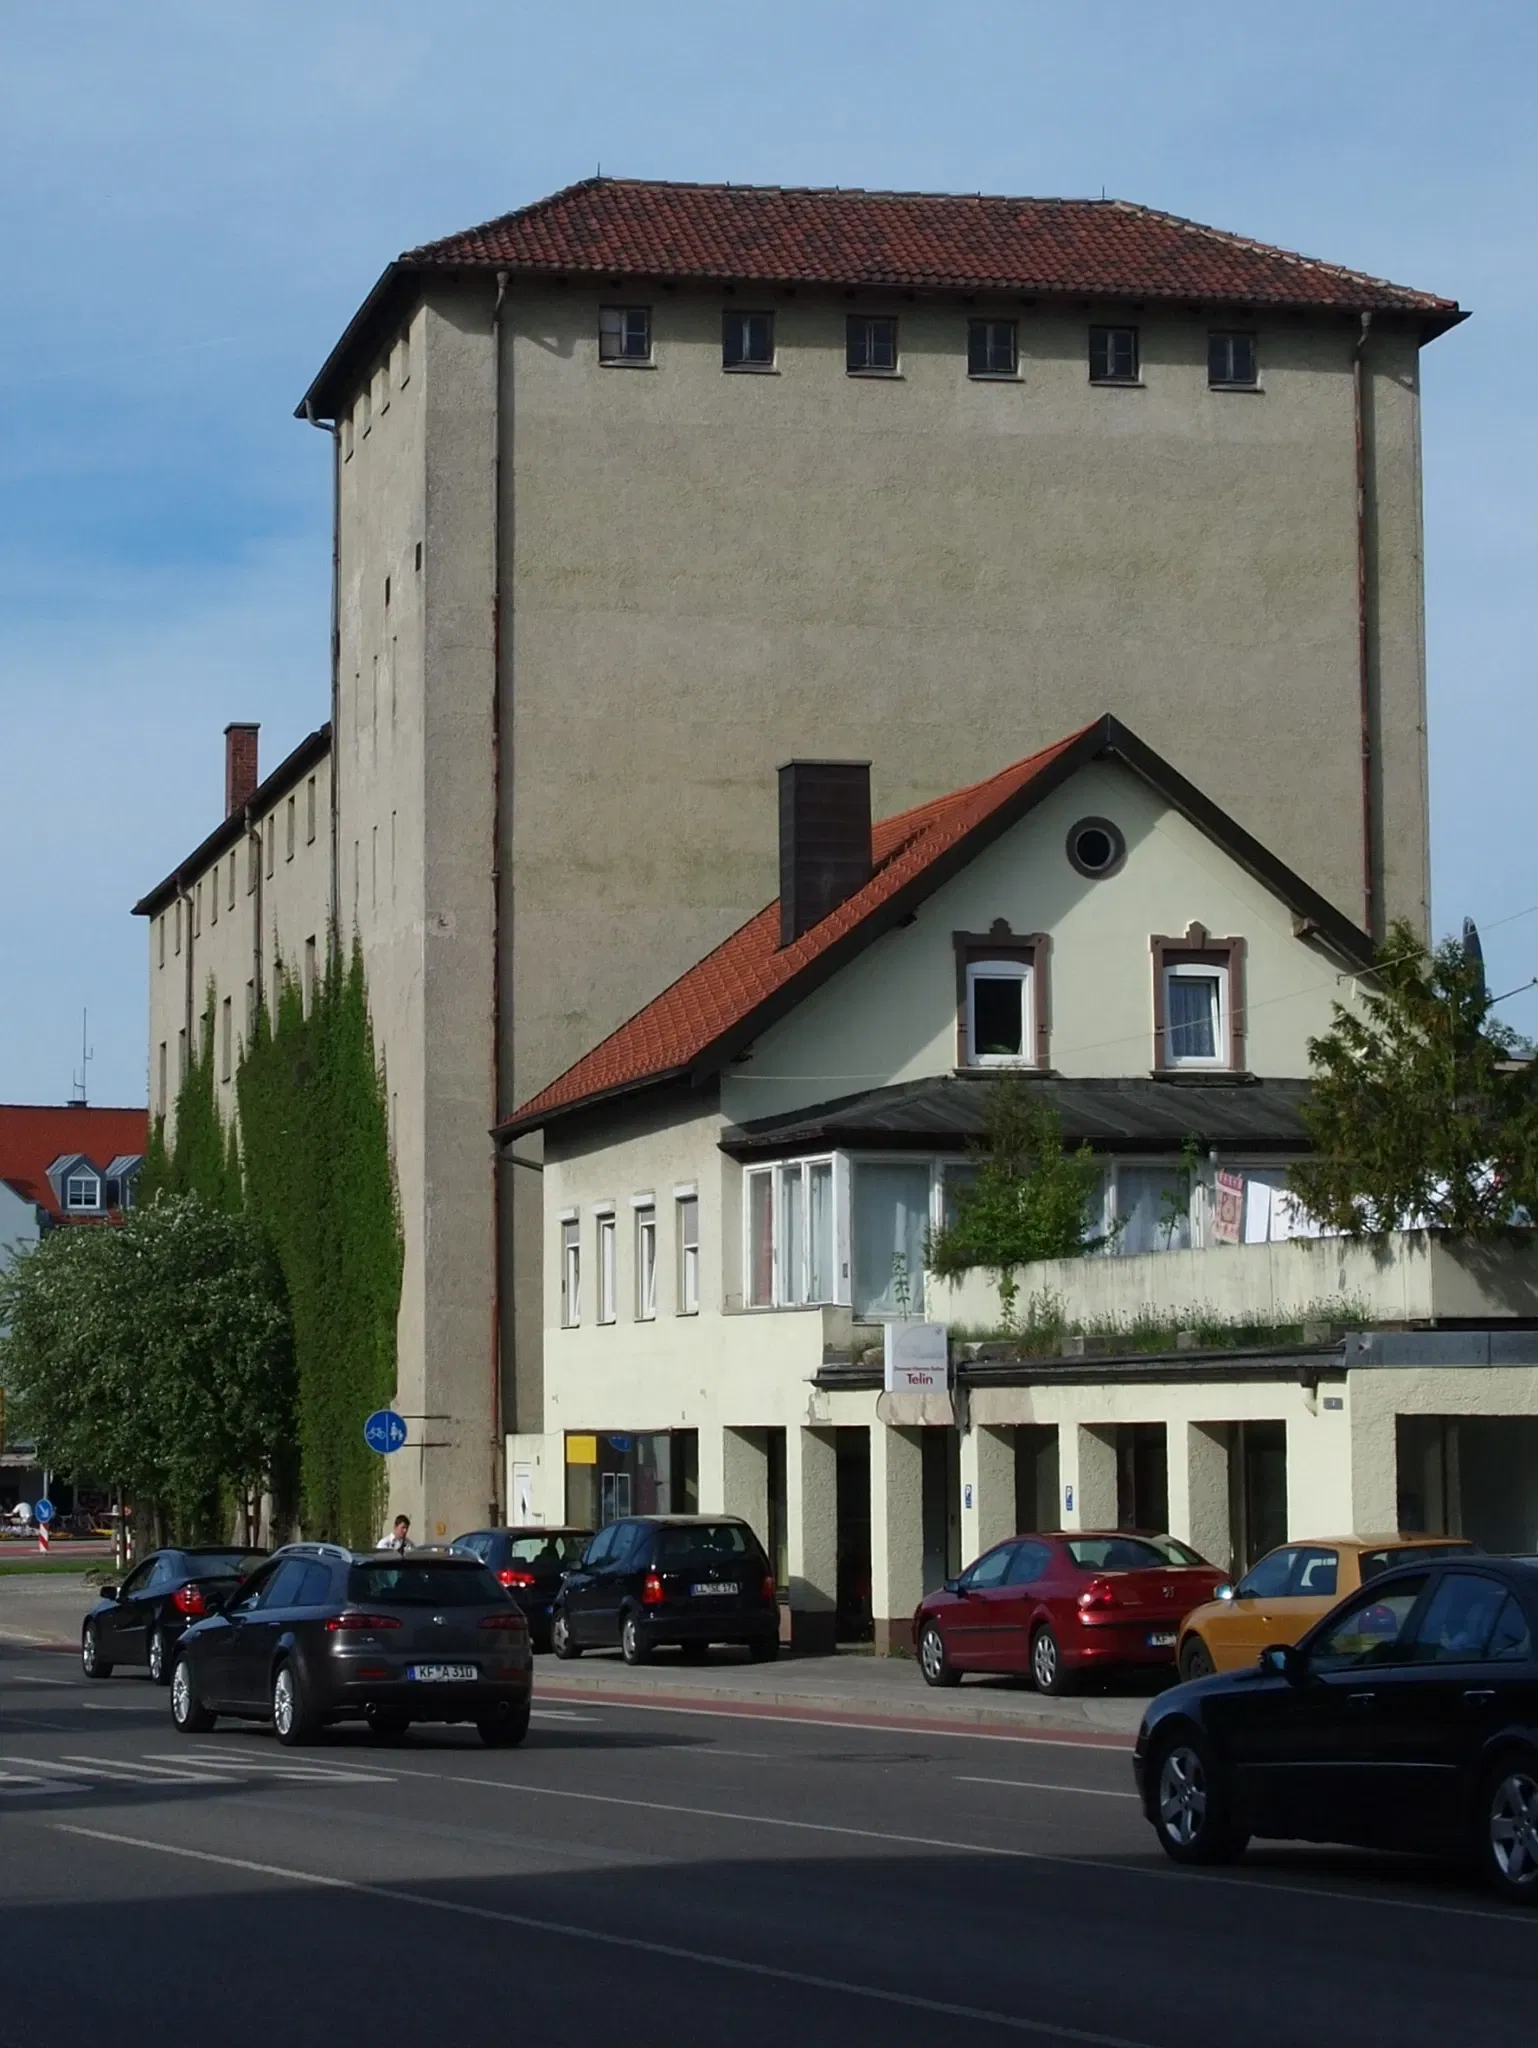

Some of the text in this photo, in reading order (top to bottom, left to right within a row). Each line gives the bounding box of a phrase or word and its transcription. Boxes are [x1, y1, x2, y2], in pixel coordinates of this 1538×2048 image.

[907, 1372, 934, 1385] Telin
[420, 1666, 473, 1678] KF A 310
